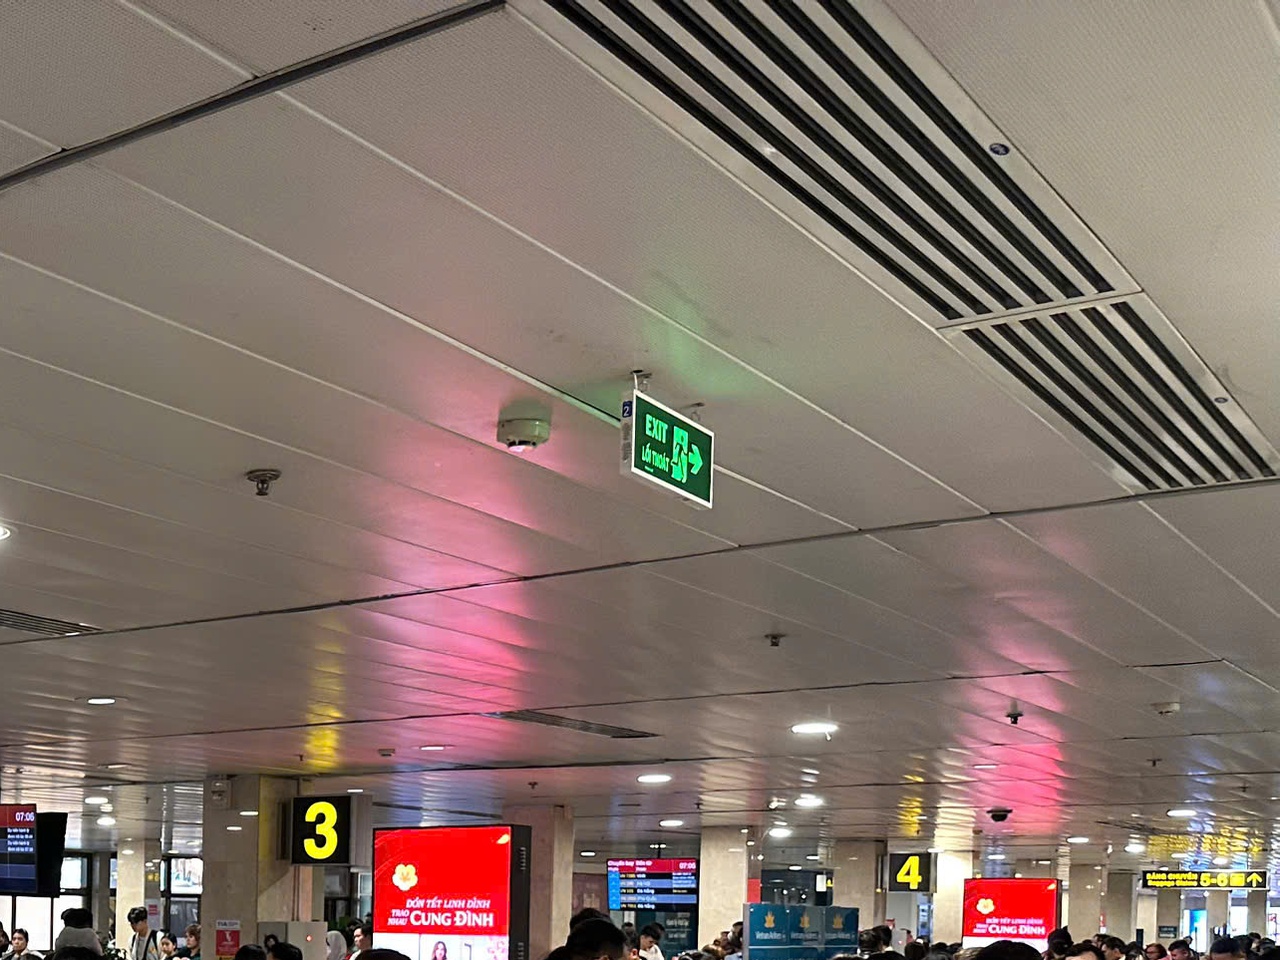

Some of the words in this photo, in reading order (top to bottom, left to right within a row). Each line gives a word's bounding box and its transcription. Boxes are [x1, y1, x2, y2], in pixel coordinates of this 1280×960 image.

[623, 406, 629, 417] 2
[645, 413, 668, 443] EXIT
[304, 801, 338, 860] 3
[896, 855, 922, 890] 4
[1200, 872, 1228, 887] 5-6
[410, 910, 452, 926] CUNG
[454, 910, 494, 927] ĐÌNH
[988, 924, 1017, 934] CUNG
